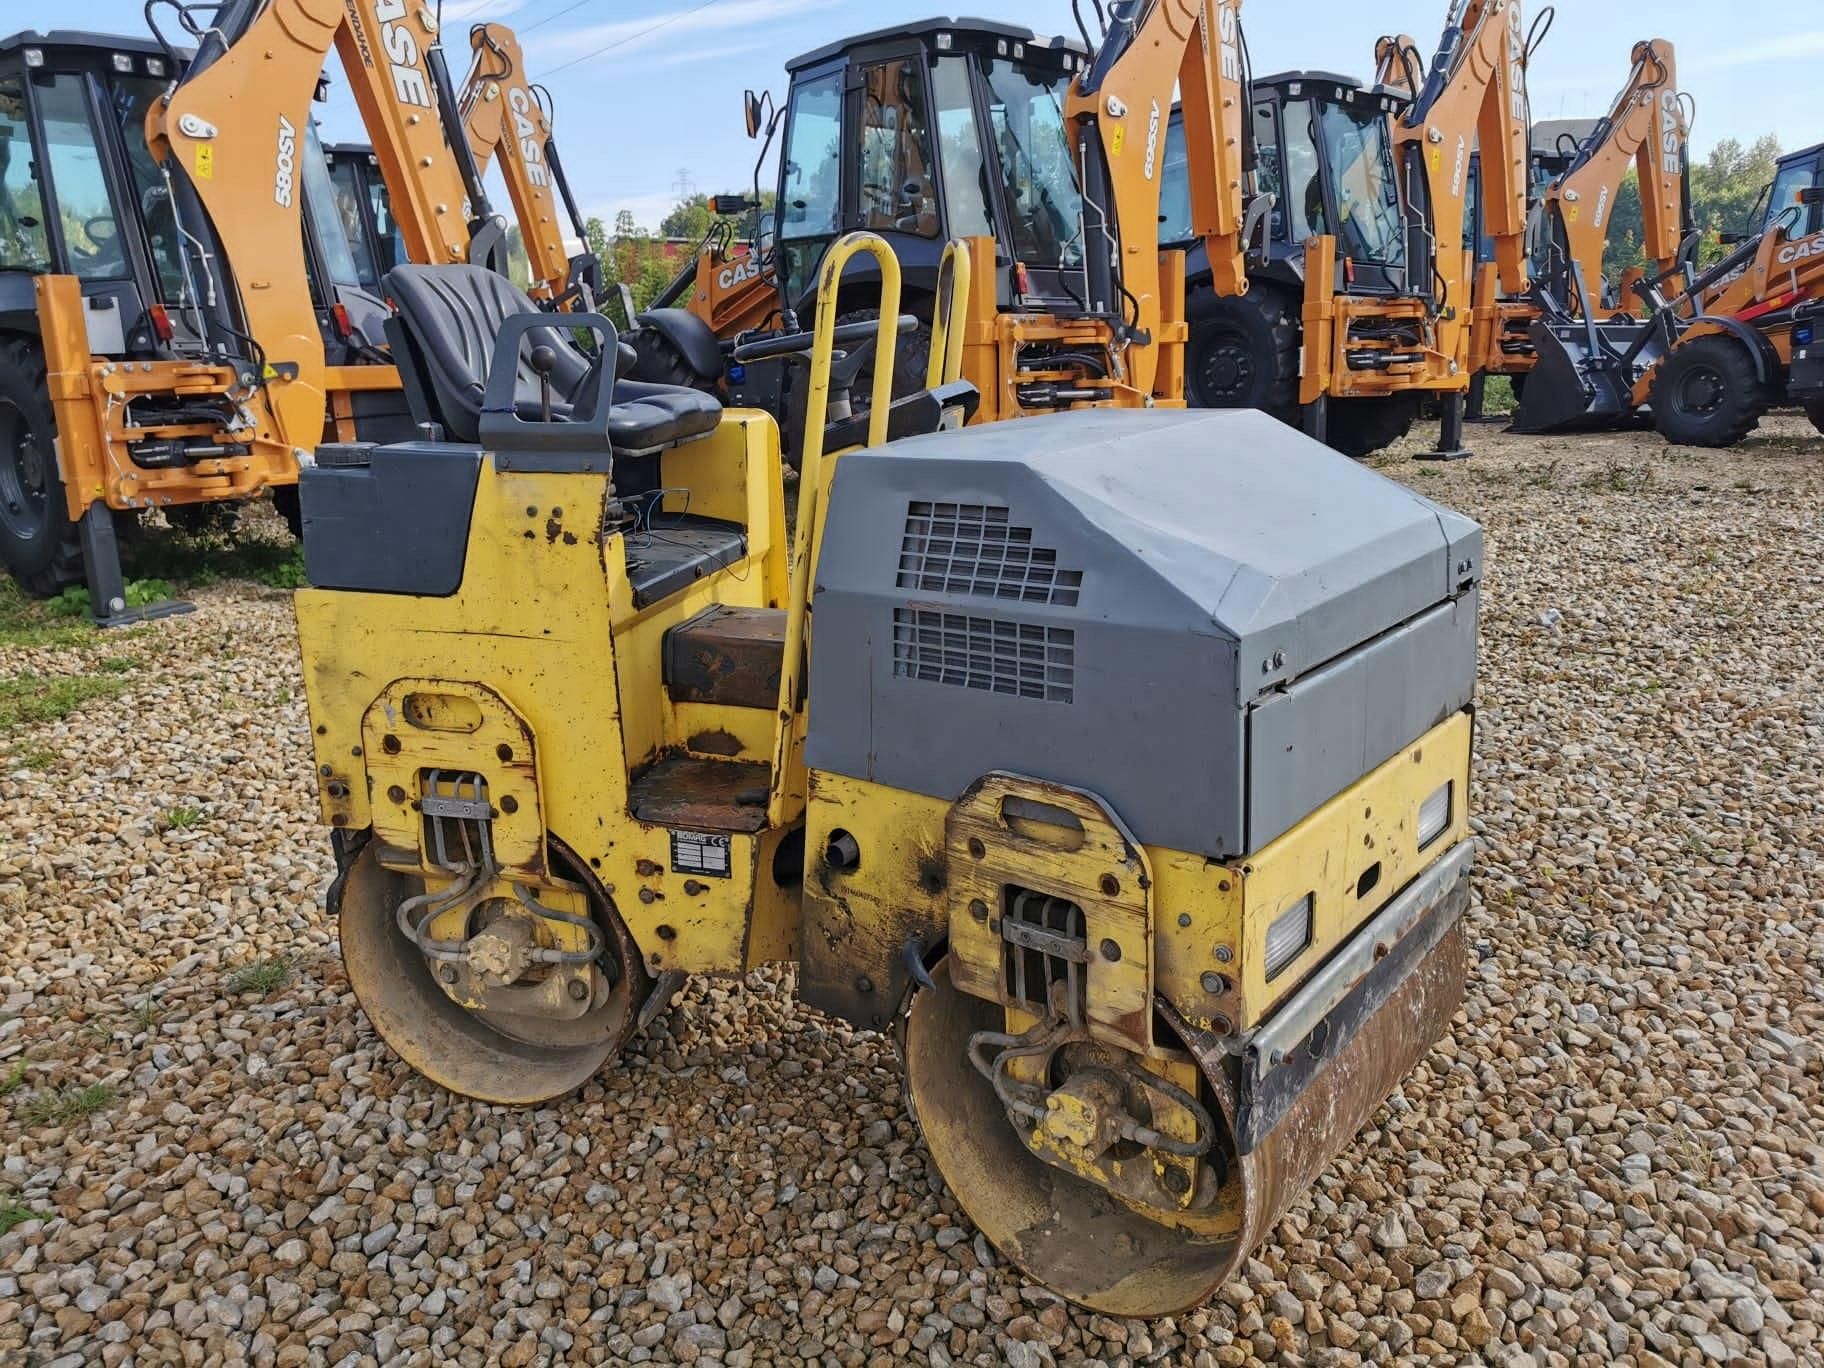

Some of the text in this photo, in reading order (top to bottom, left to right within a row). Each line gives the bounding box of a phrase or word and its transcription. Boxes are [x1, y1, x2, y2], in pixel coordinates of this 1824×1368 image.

[274, 111, 297, 208] 580SV
[508, 86, 548, 188] CASE
[1144, 96, 1160, 180] 695SV
[1661, 88, 1682, 174] CASE
